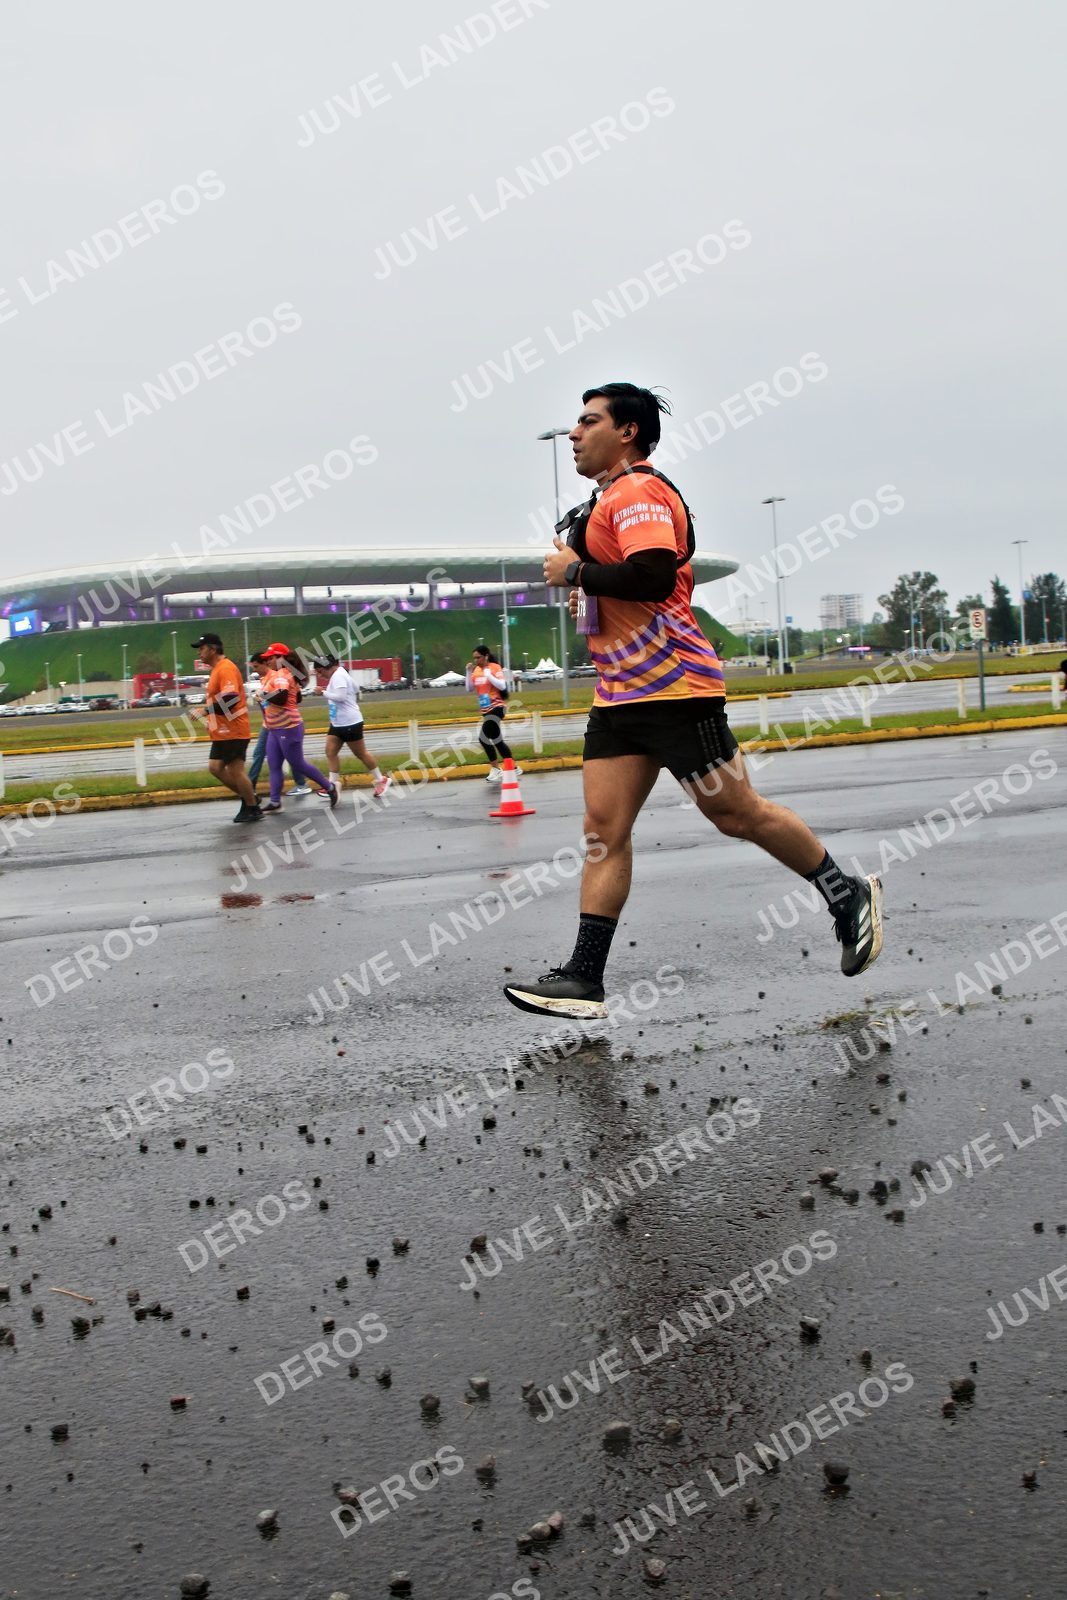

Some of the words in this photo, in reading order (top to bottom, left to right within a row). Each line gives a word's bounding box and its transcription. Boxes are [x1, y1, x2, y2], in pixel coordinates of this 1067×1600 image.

[650, 504, 664, 513] QUE
[620, 512, 650, 532] IMPULSA
[652, 513, 658, 522] A
